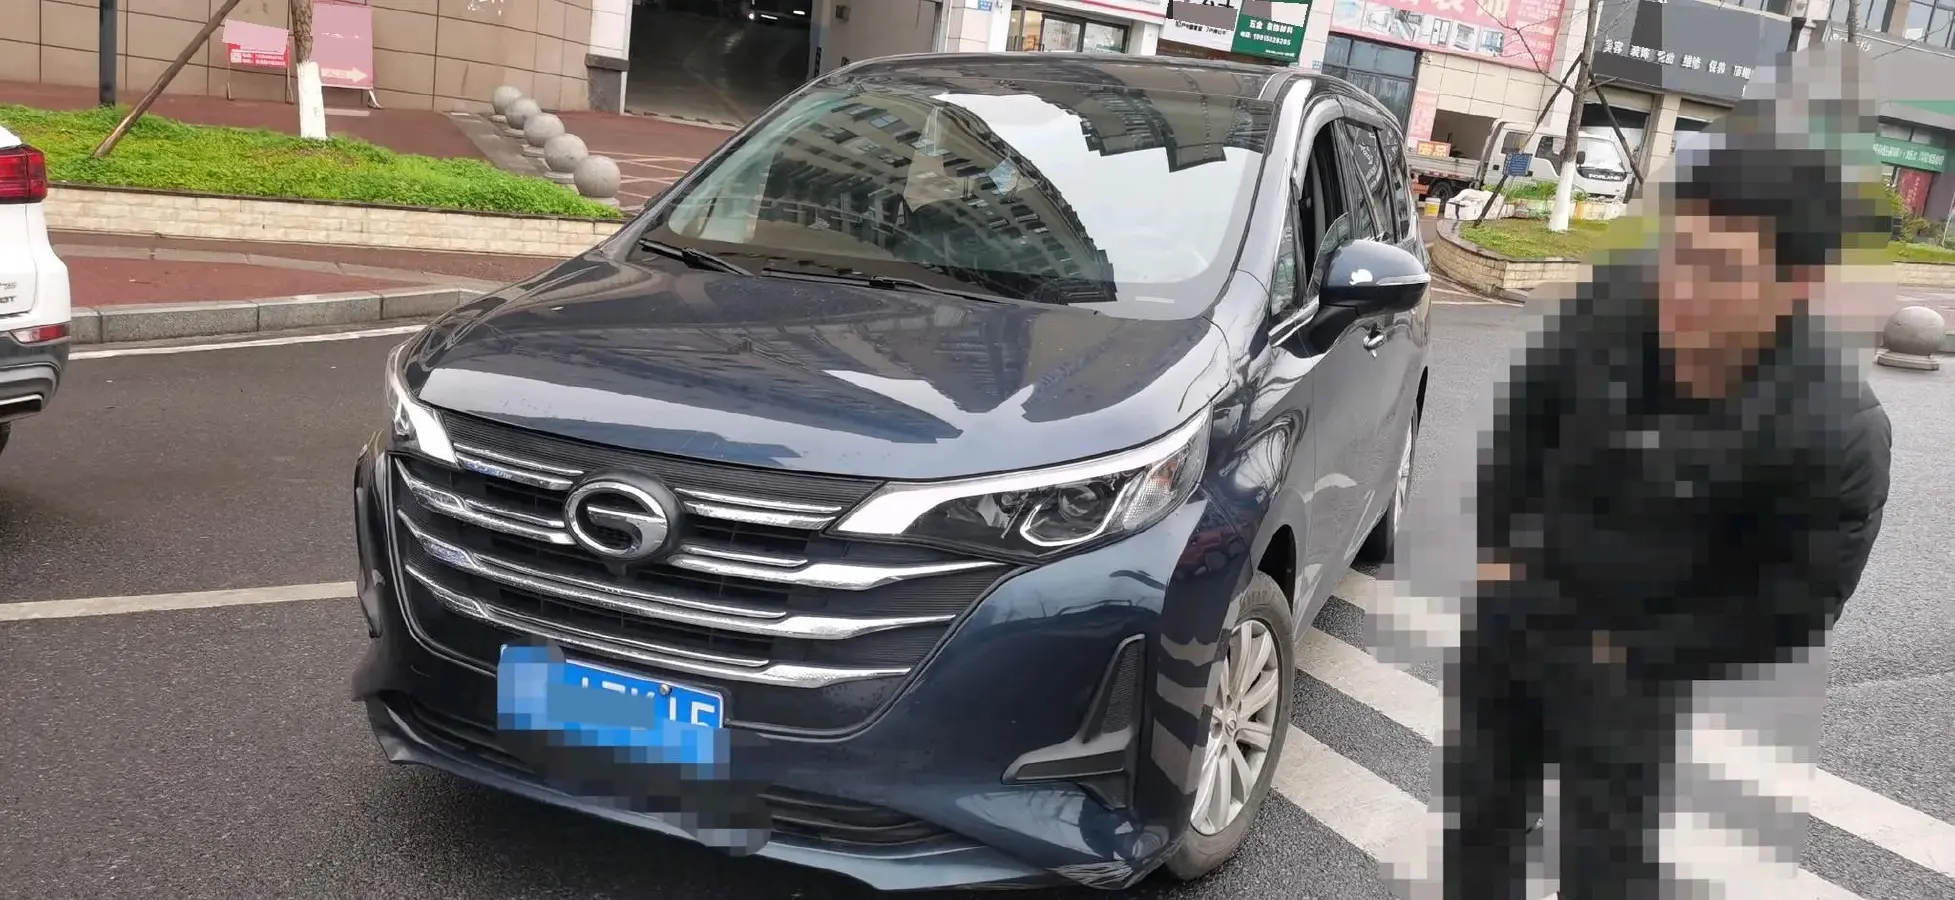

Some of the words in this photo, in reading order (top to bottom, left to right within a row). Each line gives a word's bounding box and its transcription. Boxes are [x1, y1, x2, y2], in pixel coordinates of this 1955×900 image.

[1603, 39, 1624, 54] 美容
[1681, 54, 1701, 70] 维修
[1708, 60, 1726, 74] 保养
